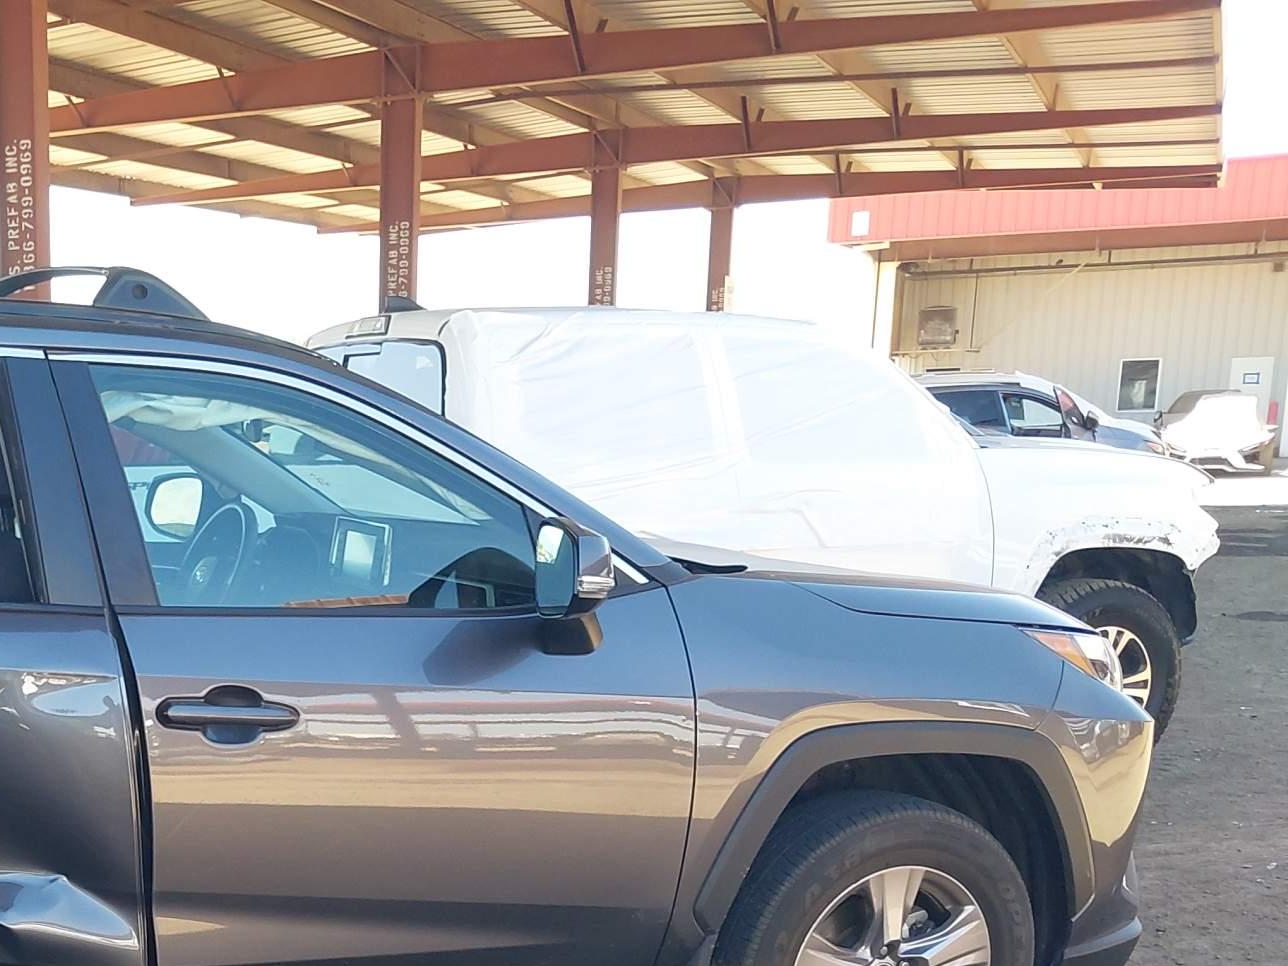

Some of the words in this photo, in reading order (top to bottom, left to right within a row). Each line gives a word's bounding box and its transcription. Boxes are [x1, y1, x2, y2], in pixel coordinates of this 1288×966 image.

[5, 139, 18, 172] INC.
[5, 182, 21, 252] PREFAB
[19, 139, 36, 292] 166-799-0969
